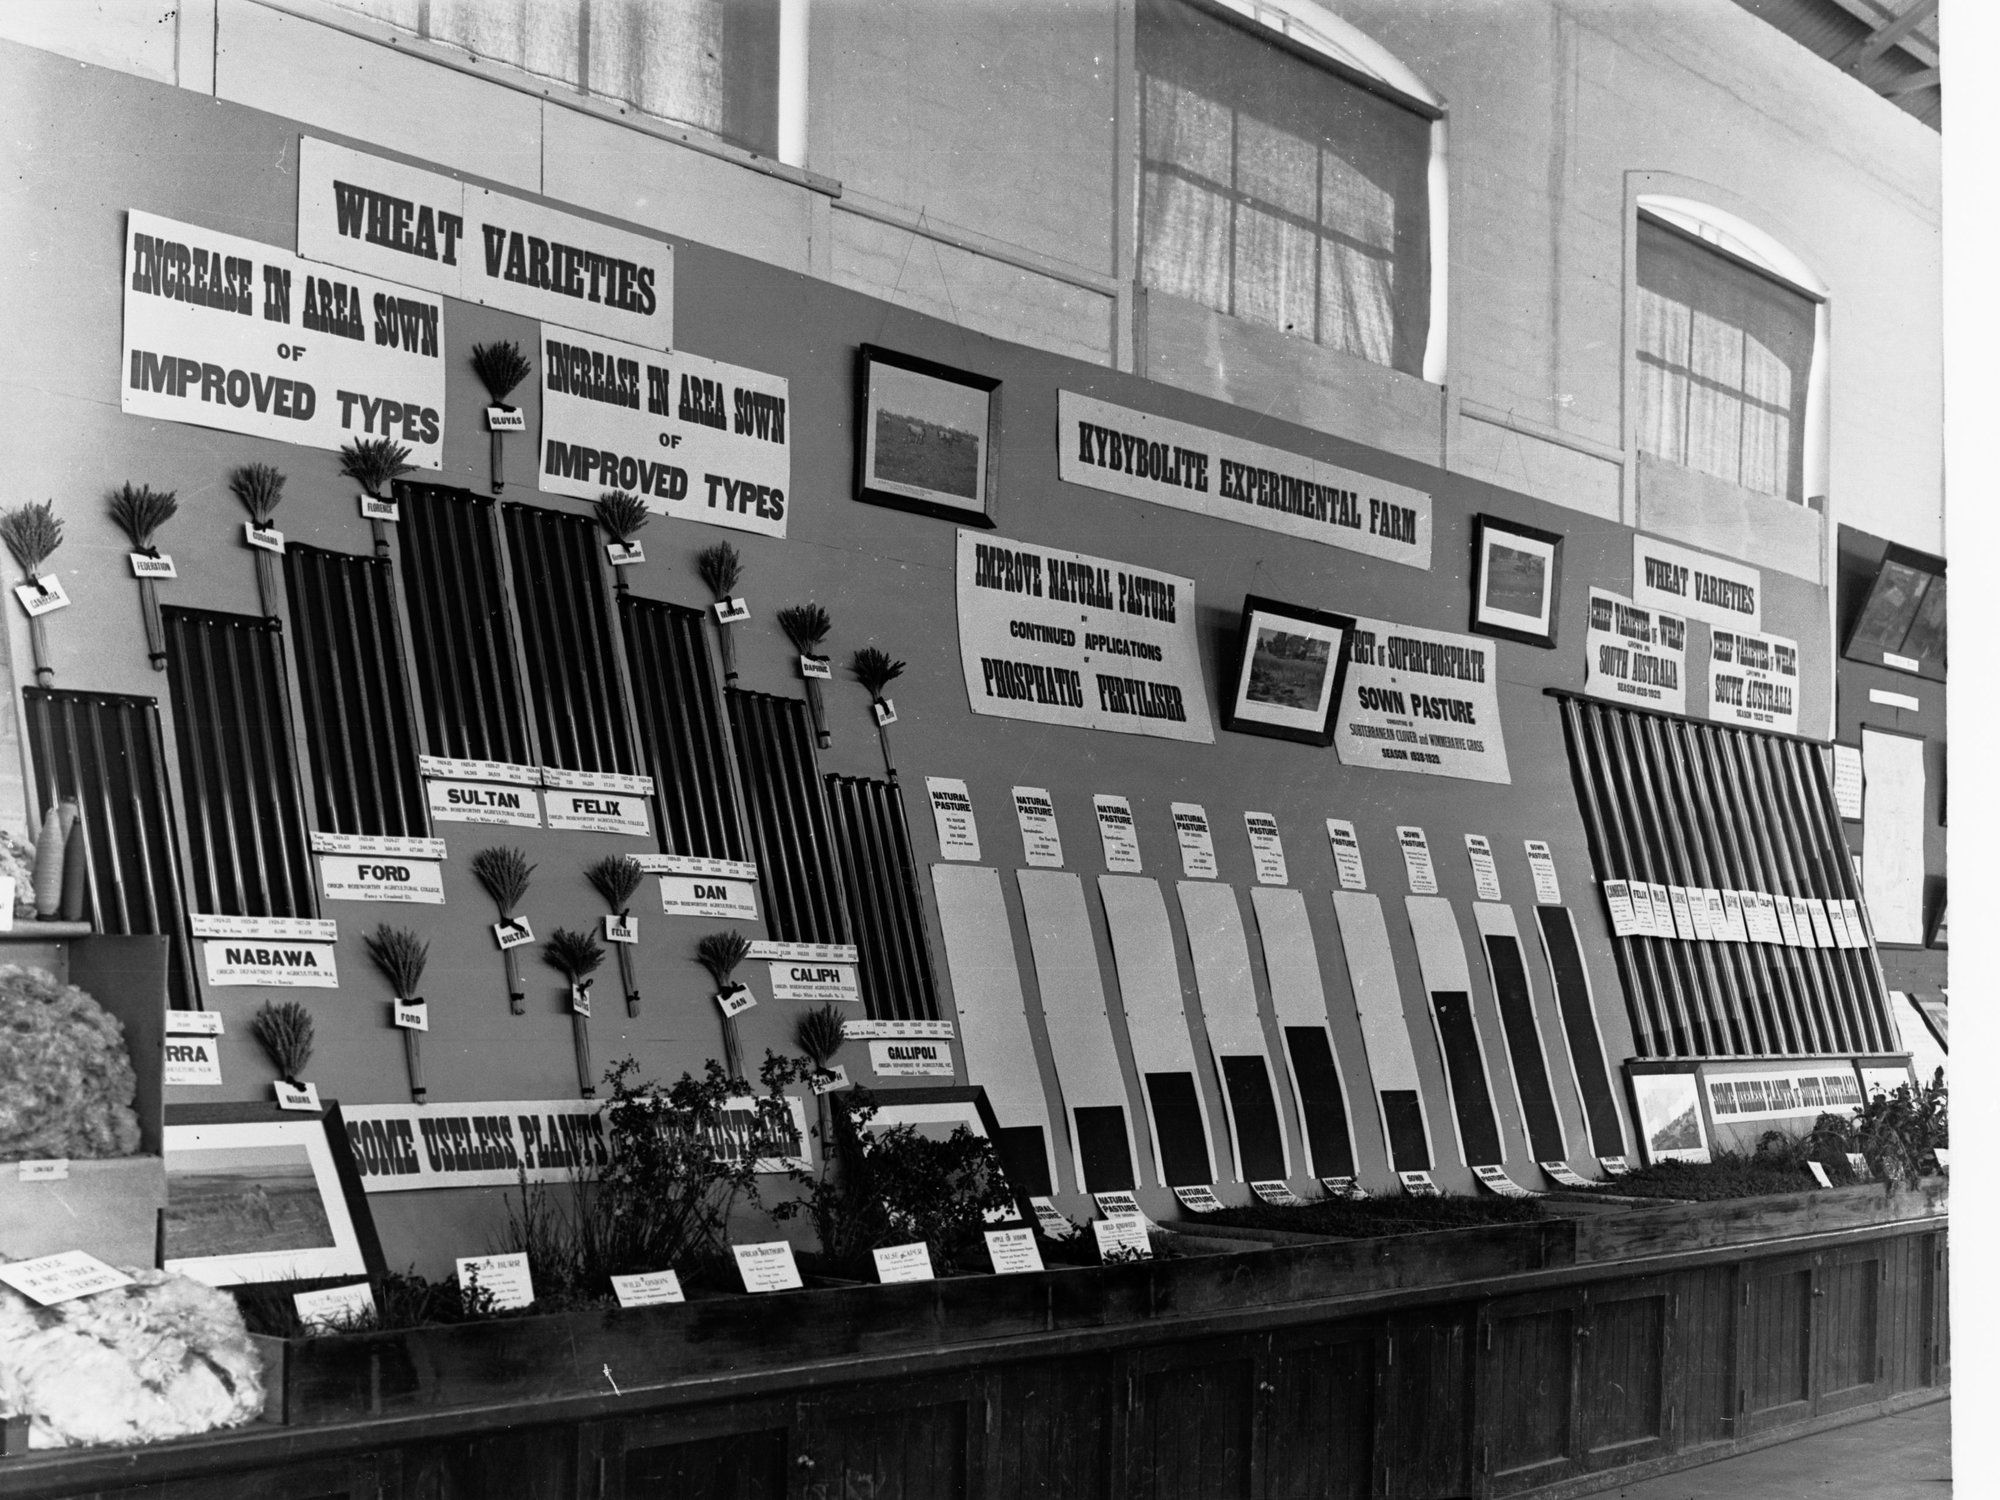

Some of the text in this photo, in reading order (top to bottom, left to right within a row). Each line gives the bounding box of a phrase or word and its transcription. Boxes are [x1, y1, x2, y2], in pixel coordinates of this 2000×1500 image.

[333, 180, 657, 316] WHEAT VARIETIES
[132, 232, 438, 358] INCREASE IN AREA SOWN
[277, 343, 306, 361] OF
[130, 349, 439, 444] IMPROVED TYPES
[546, 339, 785, 444] INCREASE IN AREA SOWN
[491, 416, 523, 425] GLUYAS
[659, 432, 682, 449] OF
[545, 438, 785, 521] IMPROVED TYPES
[1078, 420, 1416, 545] KYBYBOLITE EXPERIMENTAL FARM
[136, 561, 171, 572] FEDERATION
[975, 543, 1176, 623] IMPROVE NATURAL PASTURE
[1644, 555, 1754, 615] WHEAT VARIETIES
[1614, 602, 1650, 643] VARIETIES
[1659, 615, 1685, 652] WHEAT
[1010, 620, 1162, 662] CONTINUED APPLICATIONS
[1387, 635, 1485, 683] SUPERPHOSPHATE
[1735, 635, 1769, 670] VARIETIES
[1774, 644, 1796, 677] WHEAT
[1600, 644, 1678, 690] SOUTH AUSTRALIA
[981, 657, 1186, 722] PHOSPHATIC FERTILISER
[1617, 682, 1636, 694] SEASON
[1715, 673, 1792, 715] SOUTH AUSTRALIA
[1357, 686, 1476, 725] SOWN PASTURE
[1349, 723, 1395, 740] SUBTERRANEAN
[1395, 728, 1418, 744] CLOVER
[1418, 734, 1429, 745] and
[1466, 739, 1485, 753] GRASS
[1381, 747, 1408, 760] SEASON
[447, 788, 520, 809] SULTAN
[932, 791, 969, 802] NATURAL
[1016, 796, 1051, 807] NATURAL
[484, 809, 515, 817] AGRICULTURAL
[572, 798, 622, 816] FELIX
[934, 801, 971, 812] PASTURE
[1018, 805, 1053, 816] PASTURE
[1097, 804, 1130, 816] NATURAL
[597, 817, 626, 825] AGRICULTURAL
[1099, 813, 1132, 825] PASTURE
[1174, 813, 1206, 823] NATURAL
[1247, 818, 1276, 828] NATURAL
[1176, 822, 1208, 833] PASTURE
[1249, 826, 1278, 836] PASTURE
[1334, 828, 1350, 837] SOWN
[1403, 831, 1420, 839] SOWN
[1331, 837, 1357, 848] PASTURE
[1401, 839, 1426, 849] PASTURE
[358, 864, 410, 882] FORD
[384, 884, 418, 892] AGRICULTURAL
[693, 884, 727, 900] DAN
[1633, 889, 1648, 899] FELIX
[502, 930, 530, 945] SULTAN
[611, 927, 632, 938] FELIX
[225, 948, 318, 968] NABAWA
[790, 967, 840, 983] CALIPH
[730, 996, 747, 1010] DAN
[401, 1012, 421, 1024] FORD
[165, 1045, 209, 1062] RRA
[887, 1046, 937, 1060] GALLIPOLI
[1710, 1082, 1738, 1114] SOME
[1734, 1080, 1767, 1113] USELESS
[1763, 1078, 1796, 1111] PLANTS
[1797, 1076, 1825, 1108] SOUTH
[1821, 1075, 1862, 1105] AUSTRALIA
[346, 1118, 421, 1177] SOME
[418, 1114, 518, 1172] USELESS
[517, 1113, 608, 1170] PLANTS
[1406, 1174, 1424, 1182] SOWN
[1177, 1187, 1211, 1197] NATURAL
[1254, 1183, 1287, 1191] NATURAL
[1098, 1195, 1134, 1205] NATURAL
[1181, 1195, 1217, 1204] PASTURE
[1102, 1204, 1139, 1213] PASTURE
[901, 1248, 922, 1259] APER
